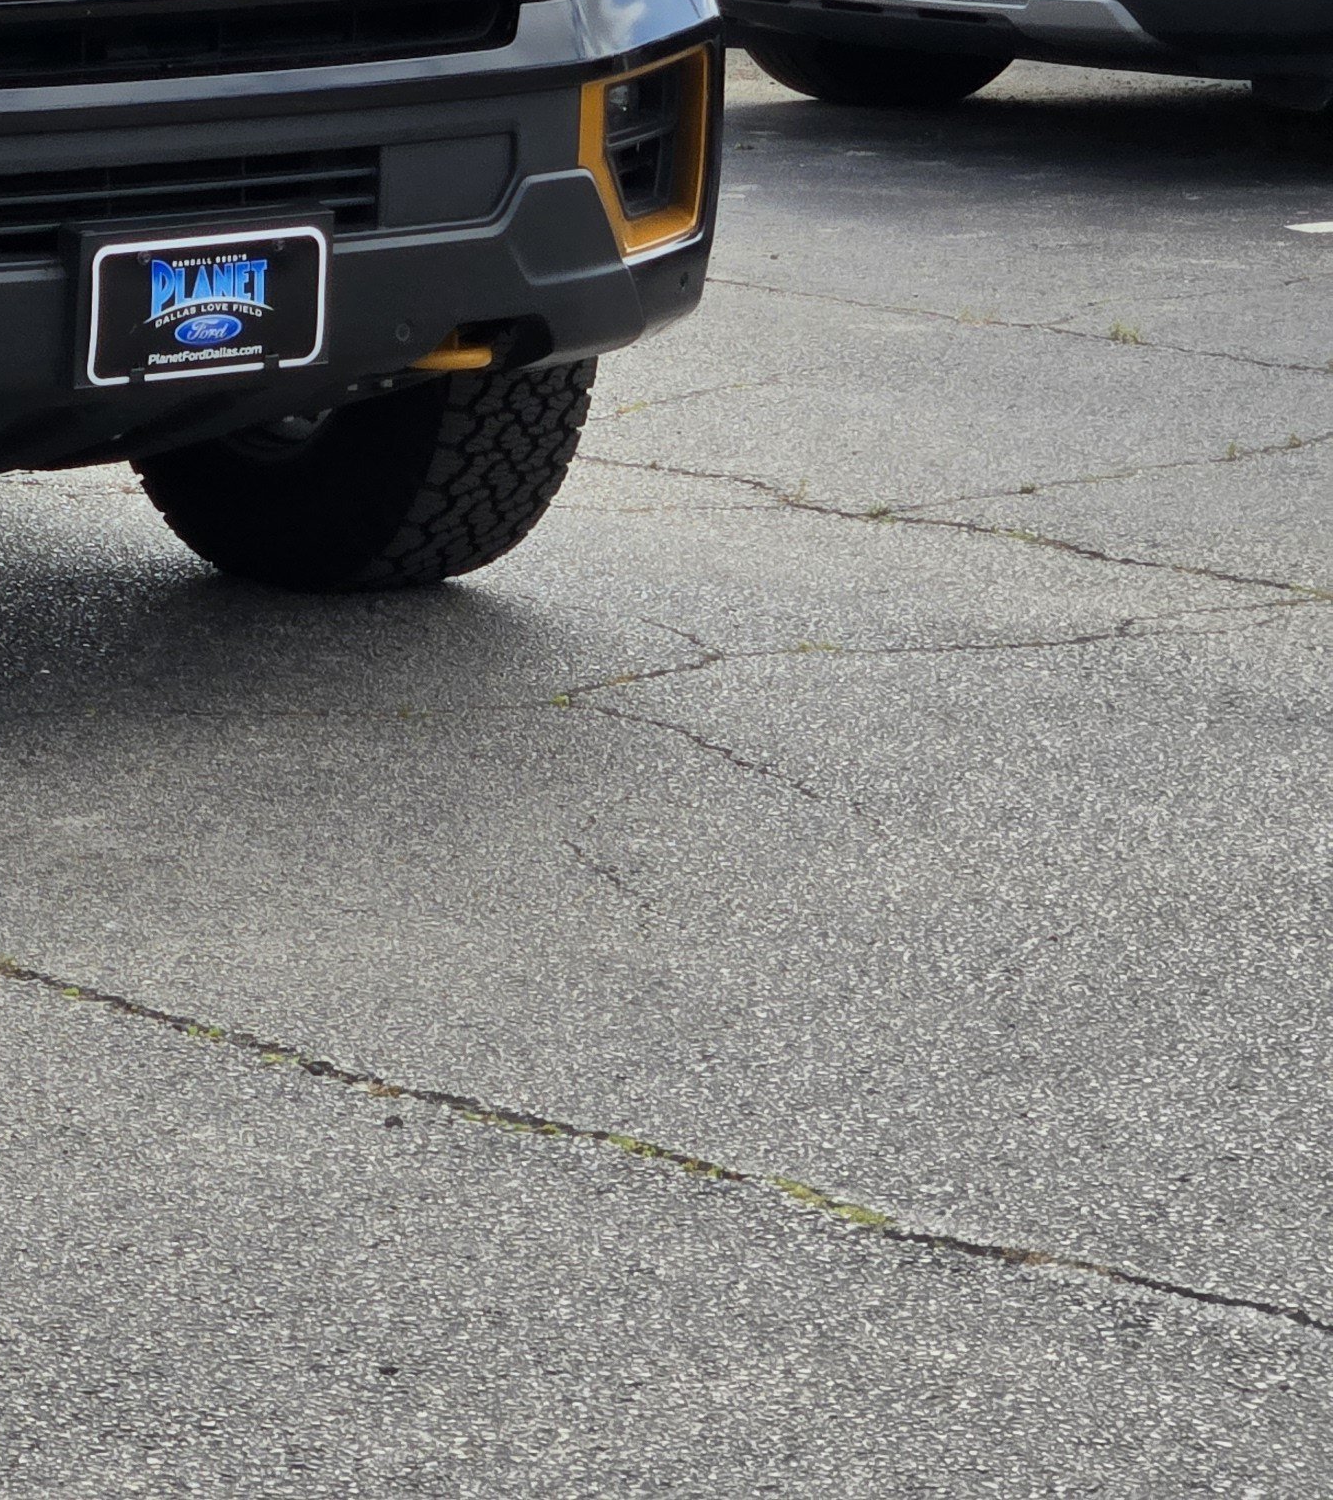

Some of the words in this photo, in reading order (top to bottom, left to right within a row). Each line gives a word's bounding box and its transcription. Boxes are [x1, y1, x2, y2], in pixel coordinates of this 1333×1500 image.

[151, 259, 267, 320] PLANET
[155, 307, 197, 329] DALLAS
[201, 303, 229, 313] LOVE
[233, 303, 263, 318] FIELD
[187, 318, 229, 340] Ford
[148, 344, 263, 366] PlanetFordDallas.com
